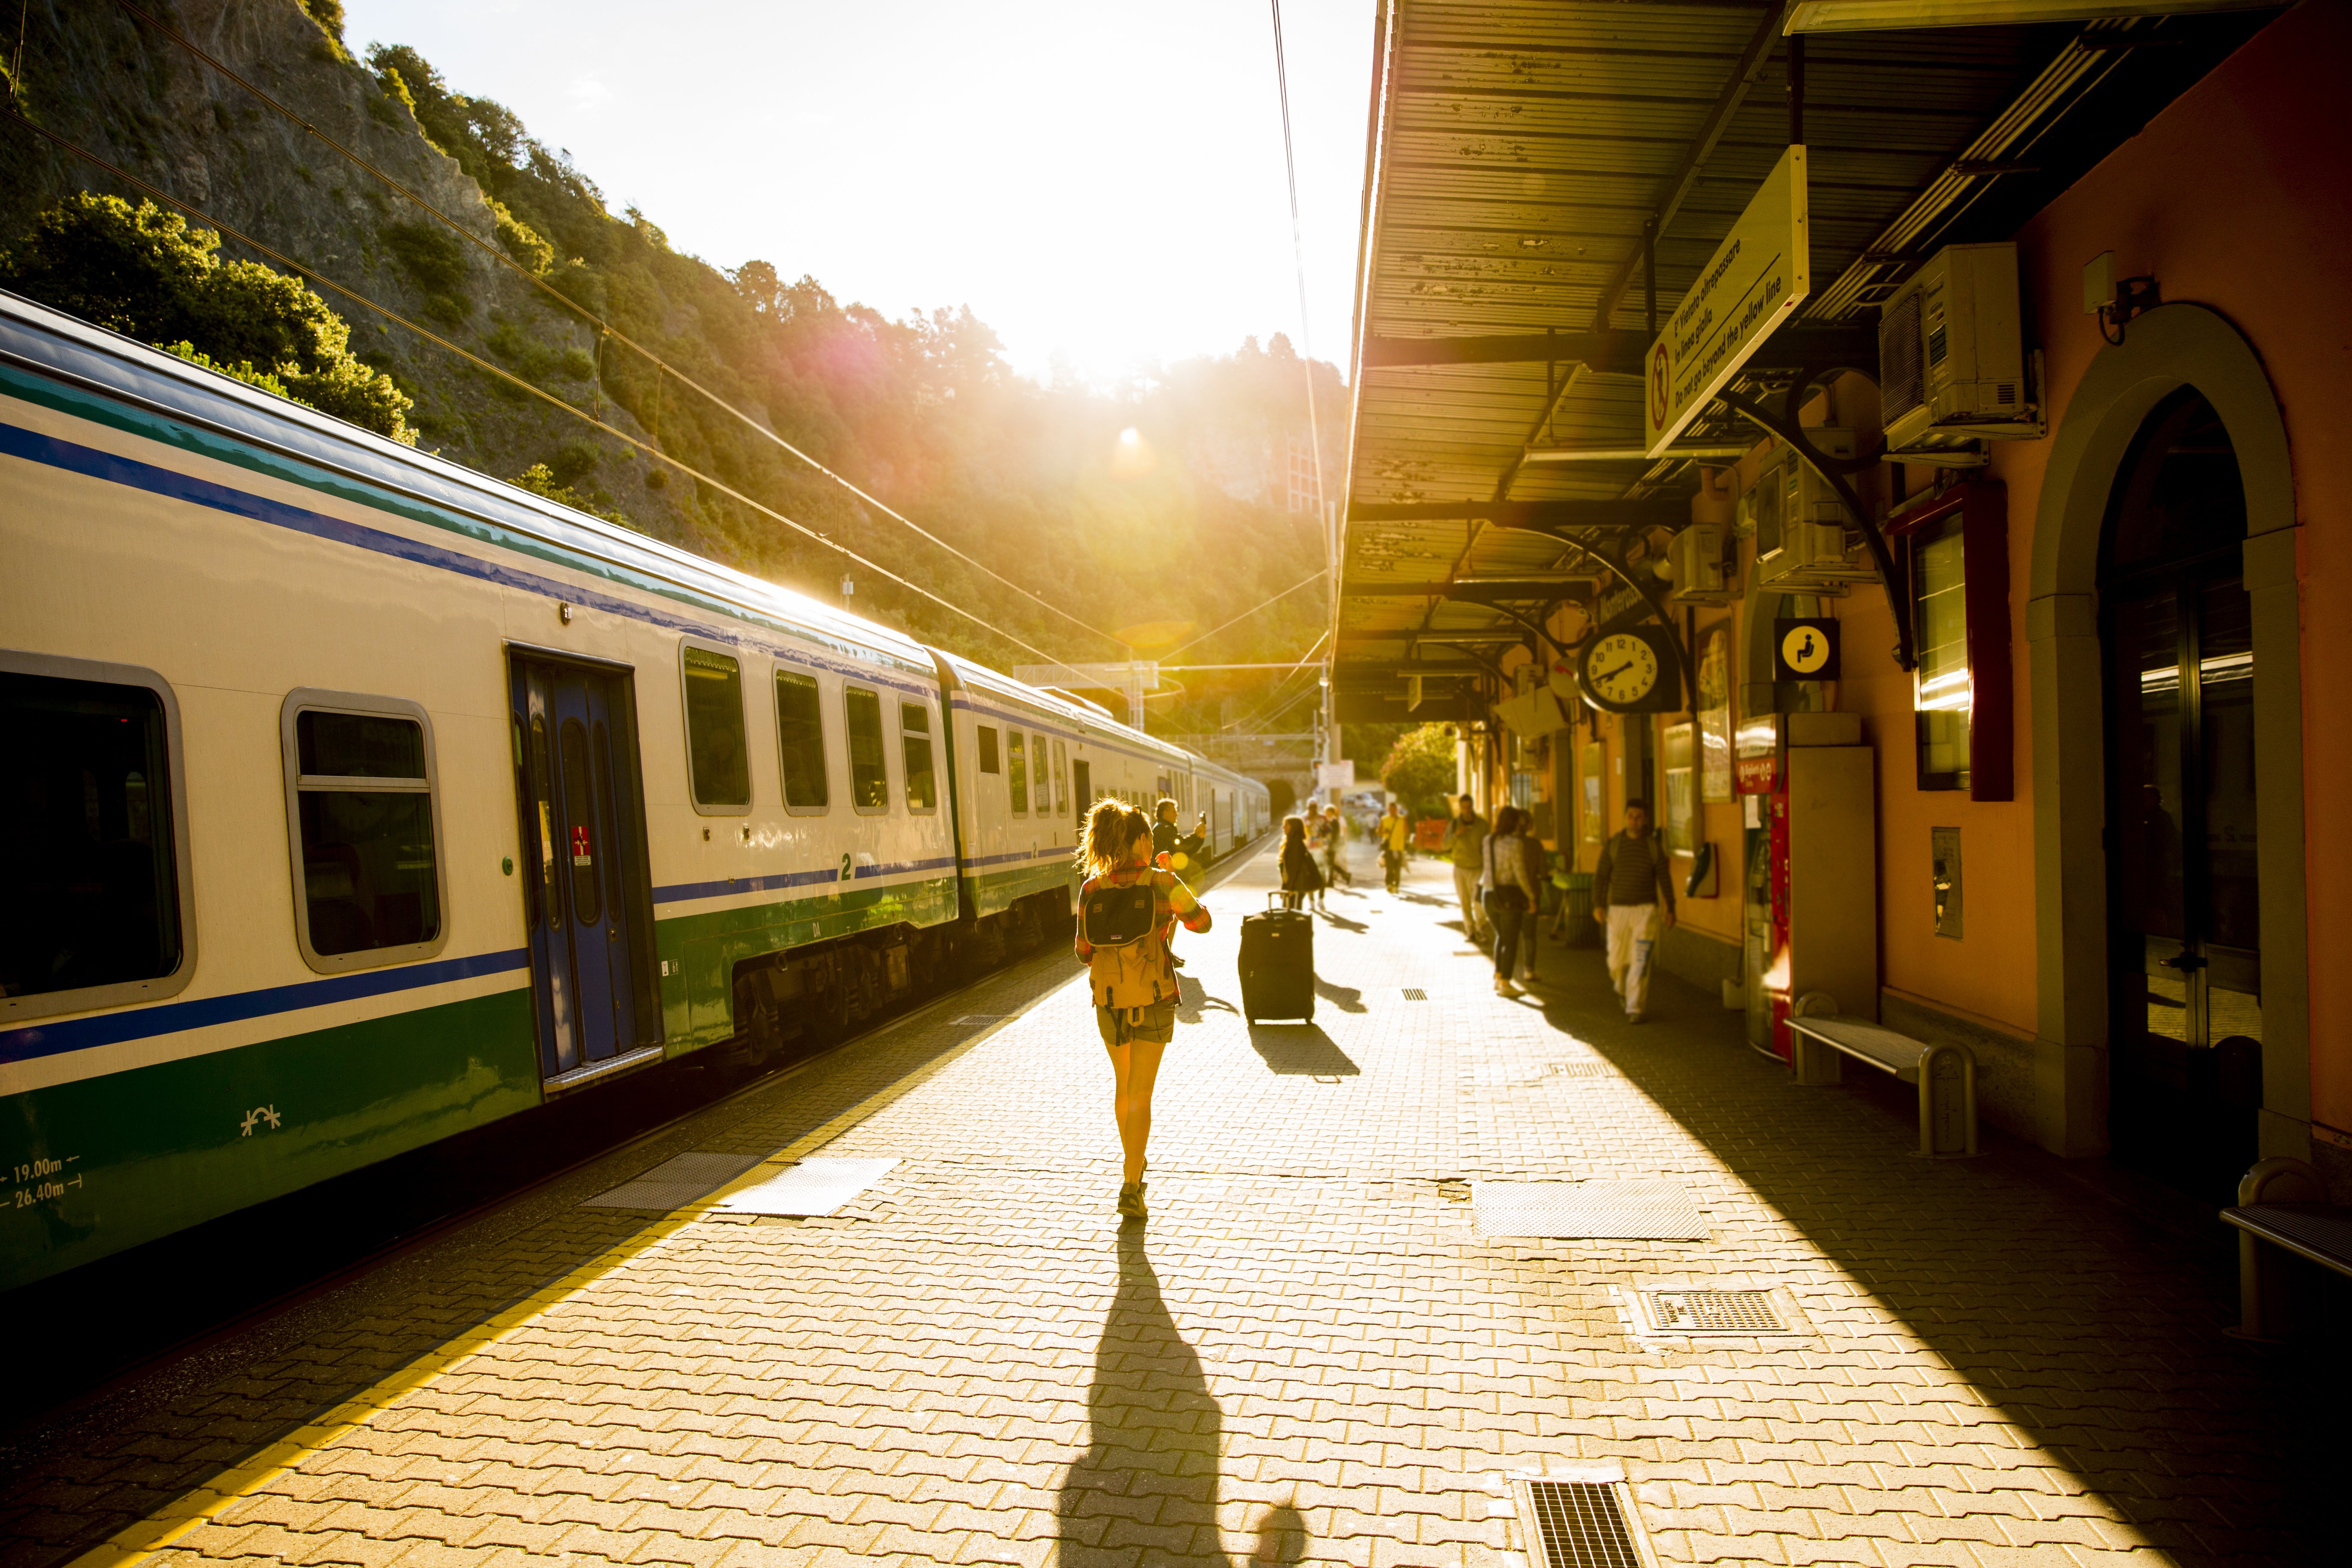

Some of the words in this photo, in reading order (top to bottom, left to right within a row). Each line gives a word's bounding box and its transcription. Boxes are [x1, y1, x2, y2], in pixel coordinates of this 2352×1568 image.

[1675, 318, 1679, 338] E'
[1680, 295, 1699, 330] Vietato
[1701, 239, 1740, 302] oltrepassare
[1675, 348, 1680, 367] la
[1681, 331, 1694, 359] linea
[1696, 307, 1712, 345] gialla
[1676, 390, 1683, 409] Do
[1684, 376, 1693, 399] not
[1694, 369, 1702, 393] go
[1703, 333, 1726, 378] beyond
[1727, 325, 1738, 350] the
[1740, 294, 1764, 341] yellow
[1766, 276, 1781, 306] line
[1606, 642, 1612, 653] 11
[1617, 639, 1625, 649] 12
[1632, 642, 1635, 652] 1
[1596, 652, 1604, 663] 10
[1641, 650, 1646, 660] 2
[1591, 664, 1597, 675] 9
[1646, 664, 1652, 674] 3
[1641, 676, 1648, 687] 4
[1607, 686, 1613, 696] 7
[1619, 689, 1625, 700] 6
[1632, 686, 1638, 697] 5
[1033, 841, 1037, 859] 2
[842, 853, 851, 880] 2
[813, 922, 821, 938] DA
[14, 1158, 62, 1183] 19.00m
[15, 1182, 64, 1208] 26.40m
